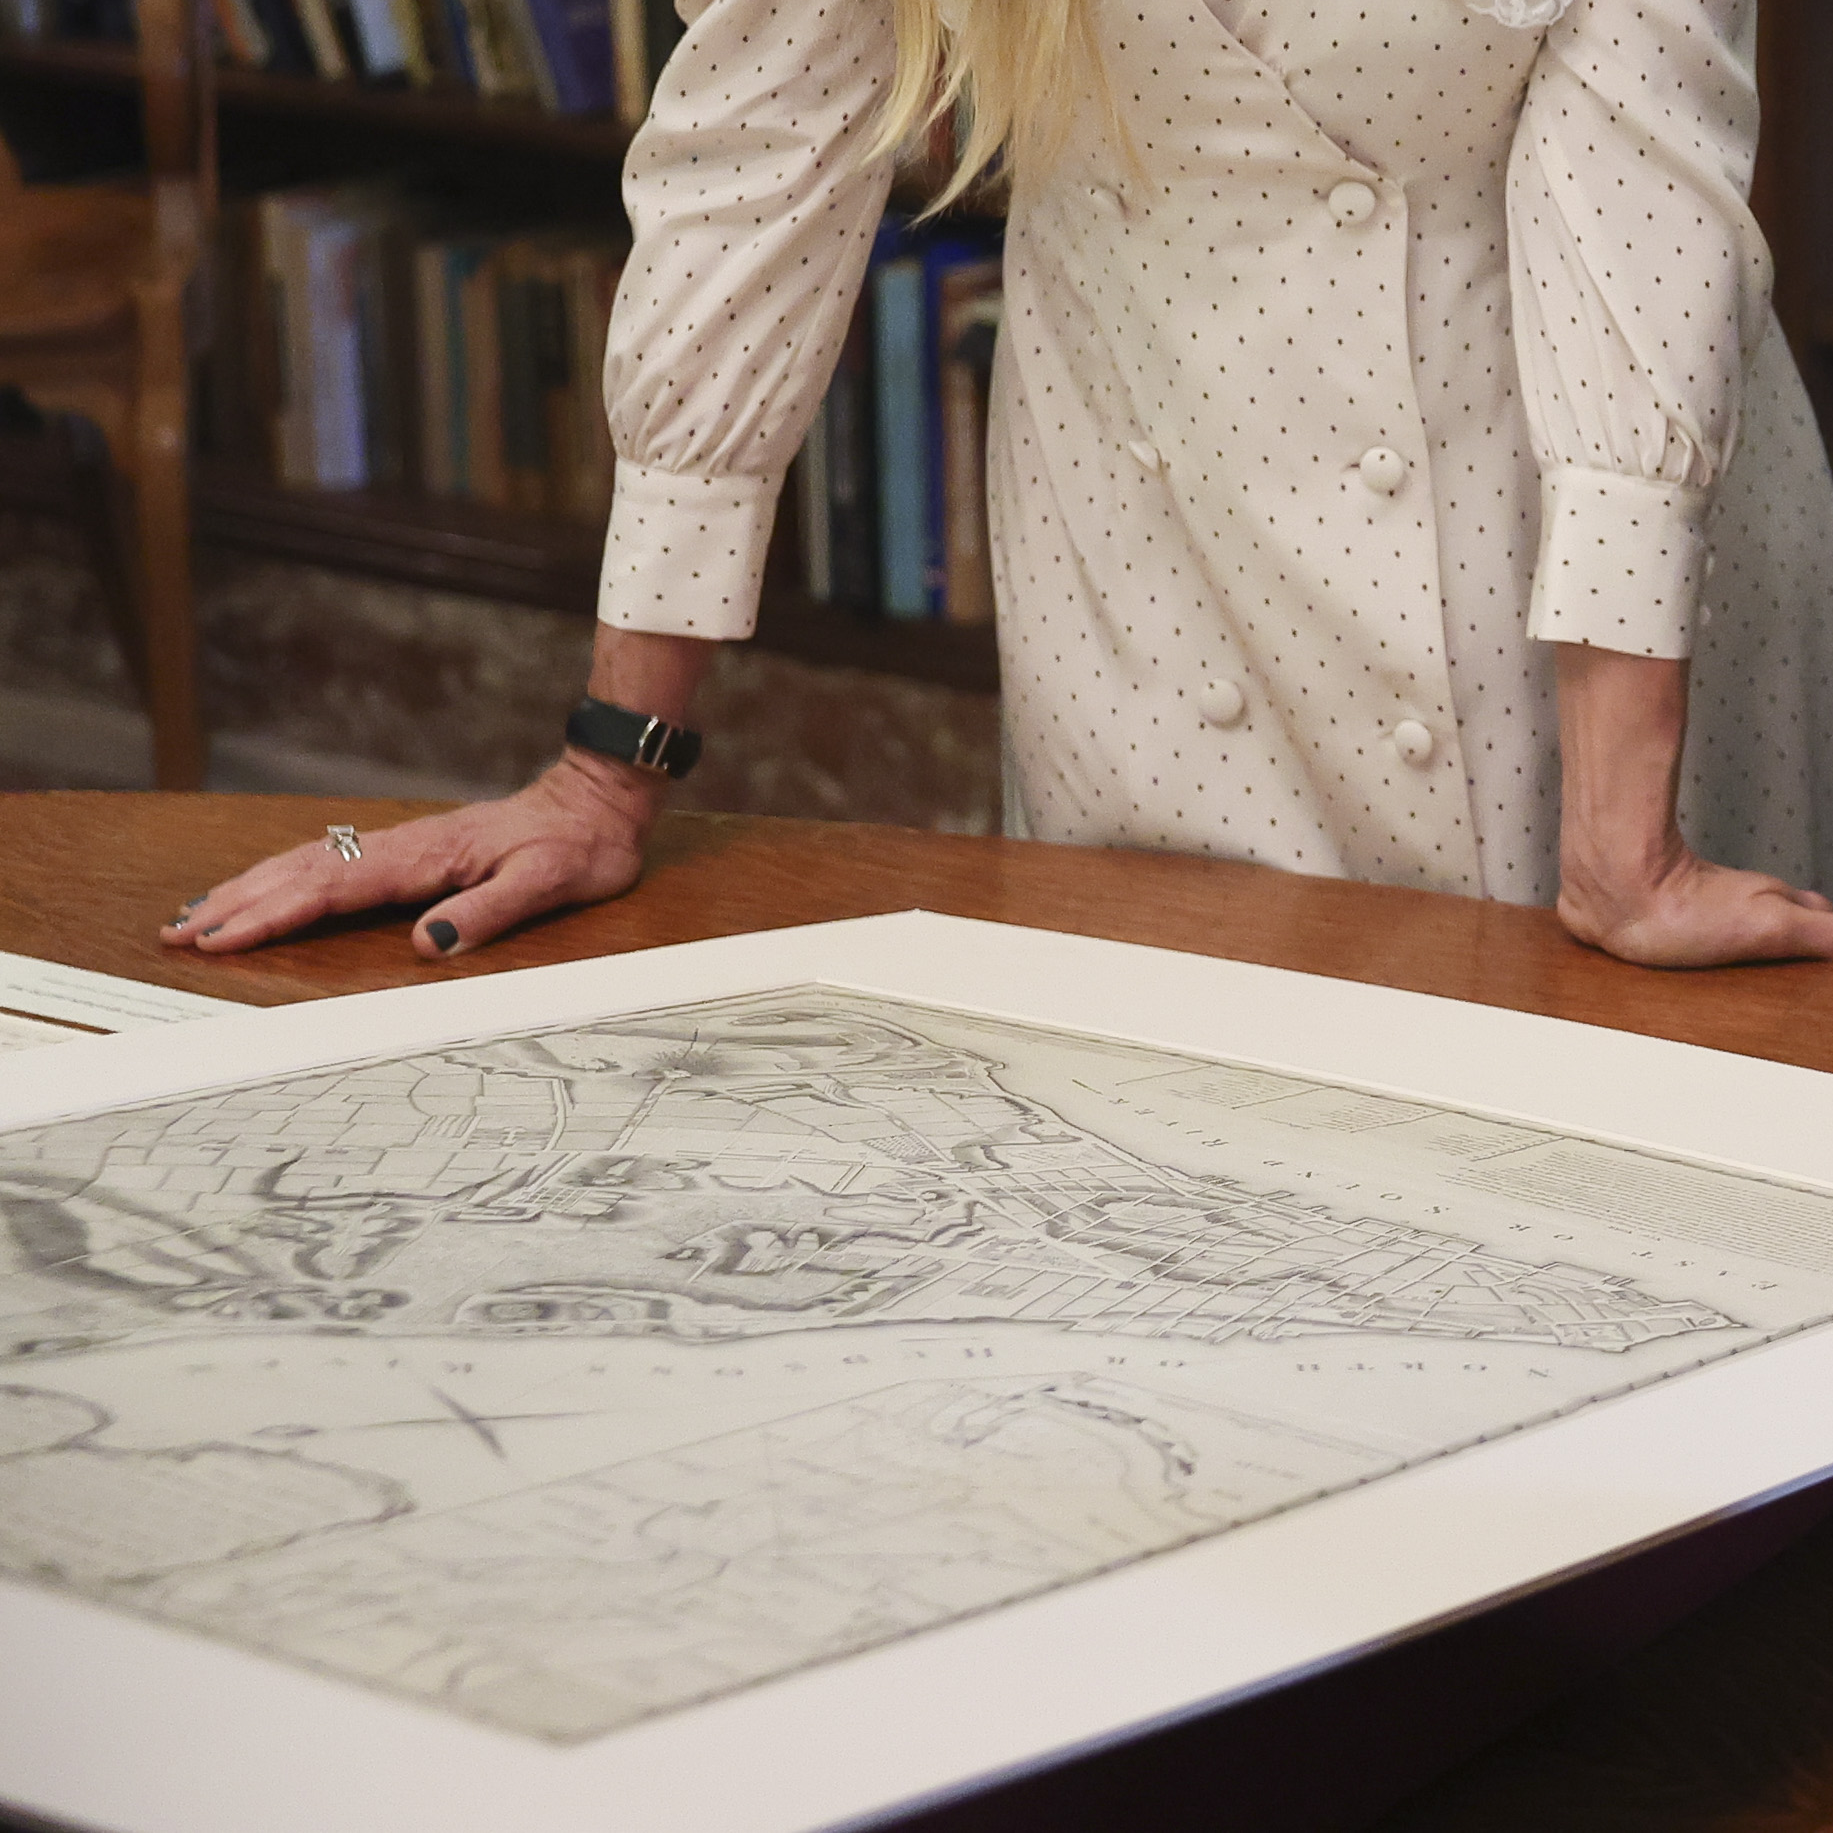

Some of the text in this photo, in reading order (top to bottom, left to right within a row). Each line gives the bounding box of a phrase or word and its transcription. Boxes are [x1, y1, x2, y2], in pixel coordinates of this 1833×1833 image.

[1262, 1160, 1450, 1216] SOUND
[1508, 1223, 1575, 1242] OR
[1631, 1249, 1779, 1291] EAST
[1295, 1361, 1551, 1380] NORTH
